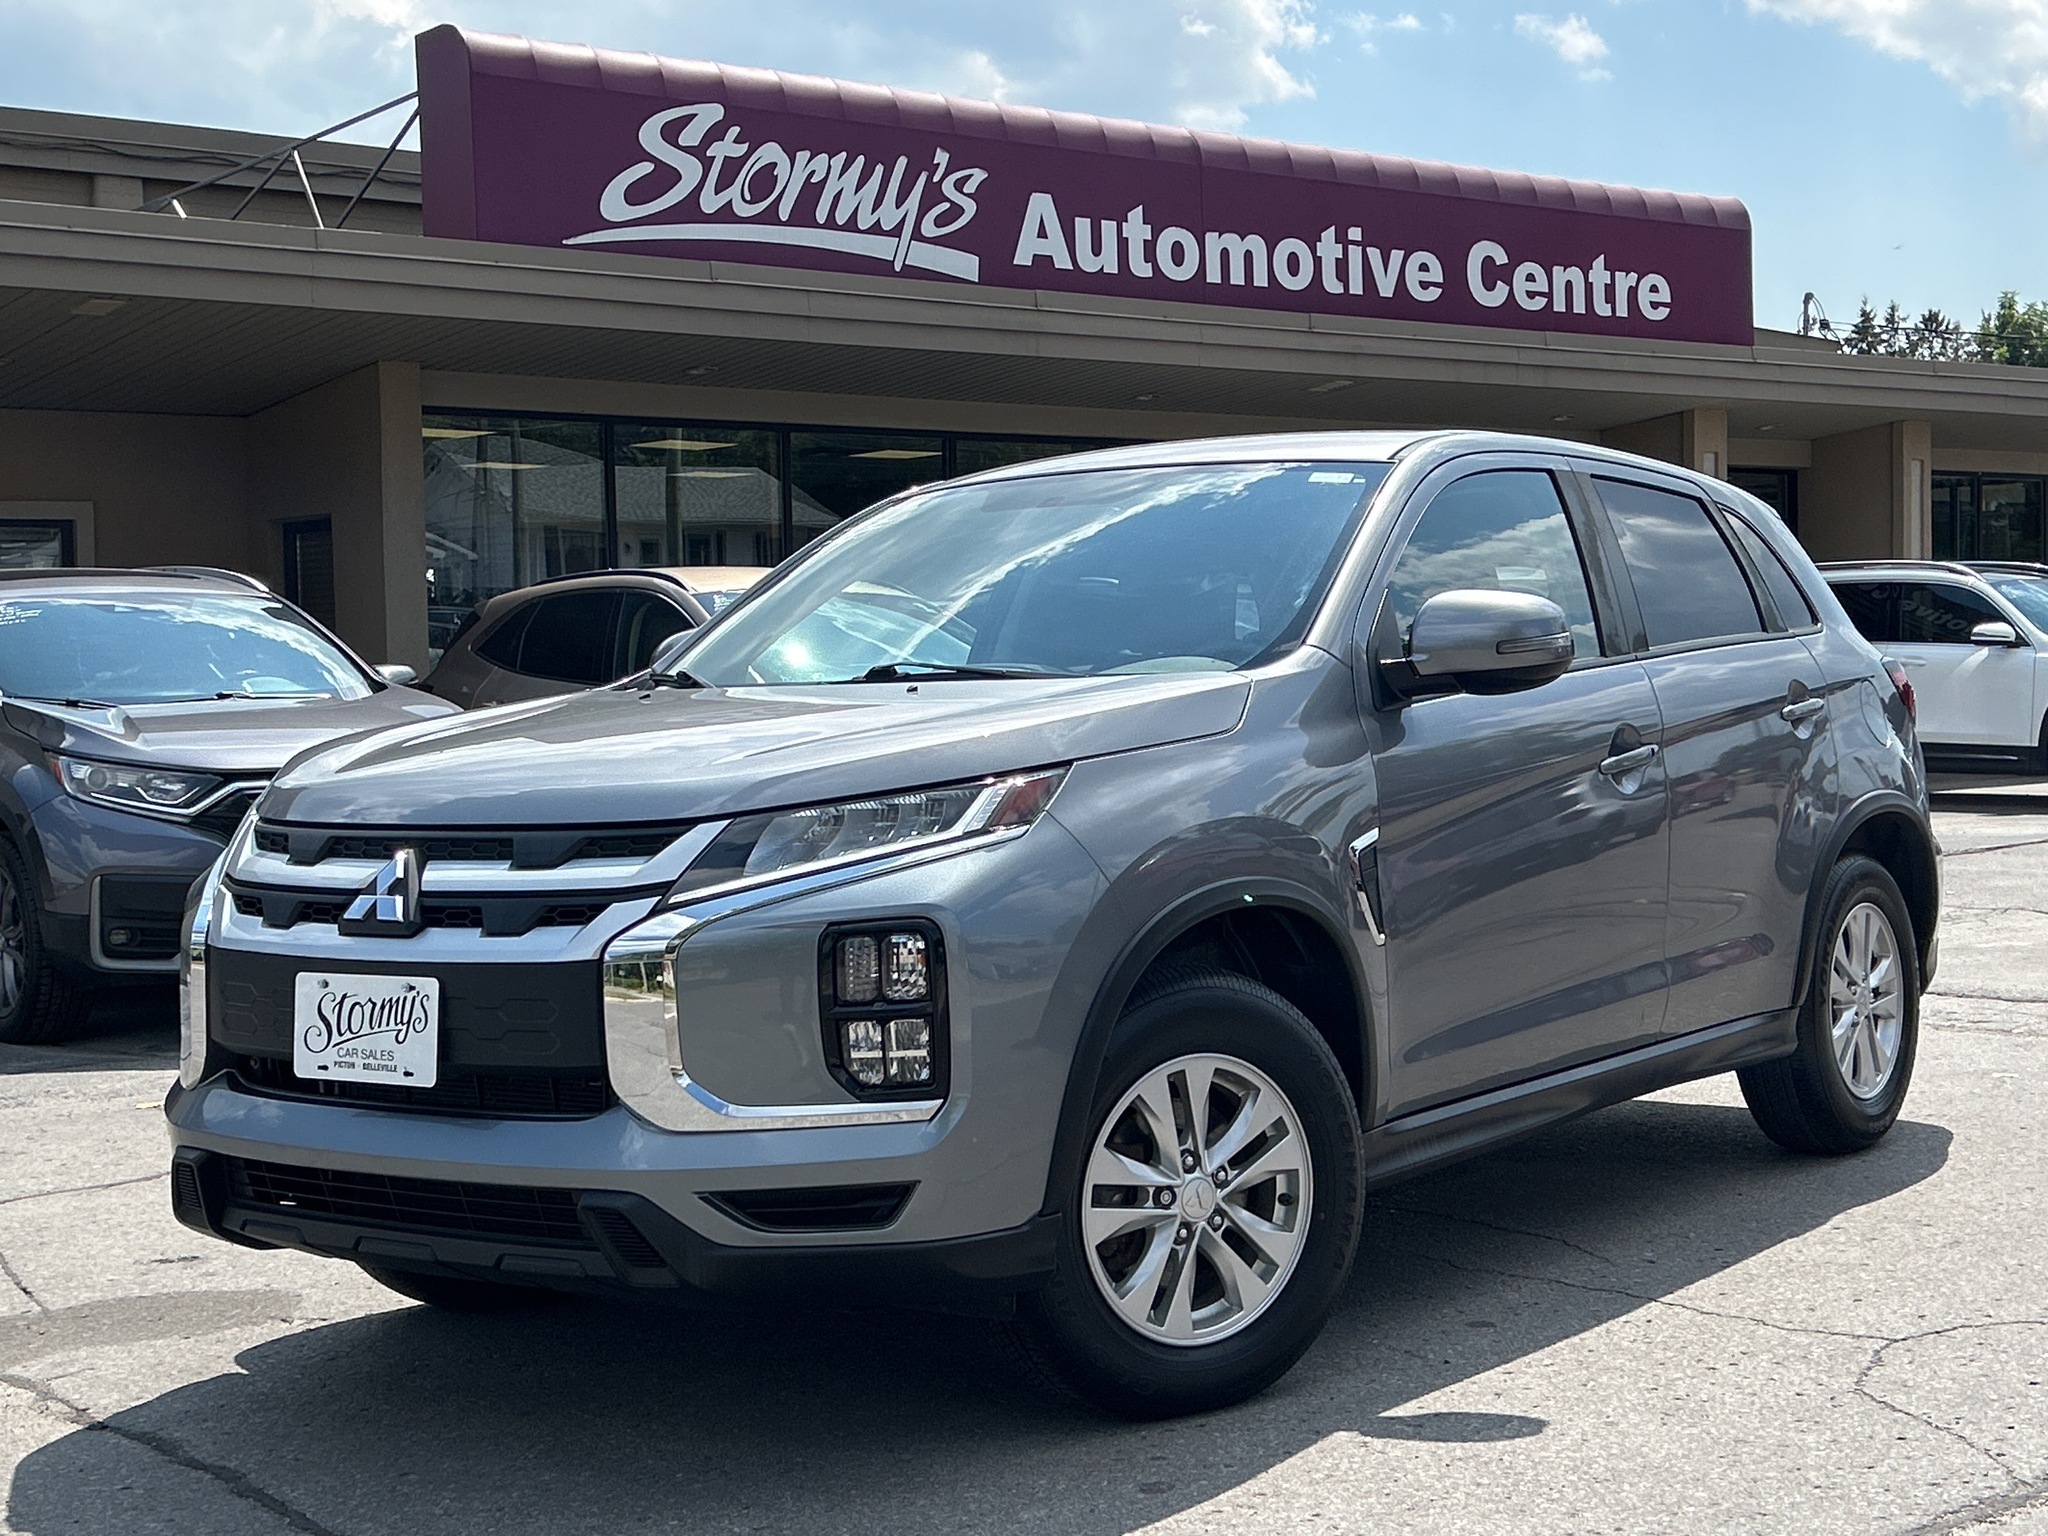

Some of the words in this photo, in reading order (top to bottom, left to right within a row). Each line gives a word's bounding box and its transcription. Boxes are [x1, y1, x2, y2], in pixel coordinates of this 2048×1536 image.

[599, 102, 988, 271] Stormy's
[1012, 192, 1444, 302] Automotive
[1466, 240, 1672, 321] Centre
[304, 990, 430, 1054] Stormy's
[333, 1060, 356, 1070] PICTON
[362, 1062, 398, 1073] BELLEVILLE
[337, 1047, 359, 1058] CAR
[360, 1049, 395, 1061] SALES
